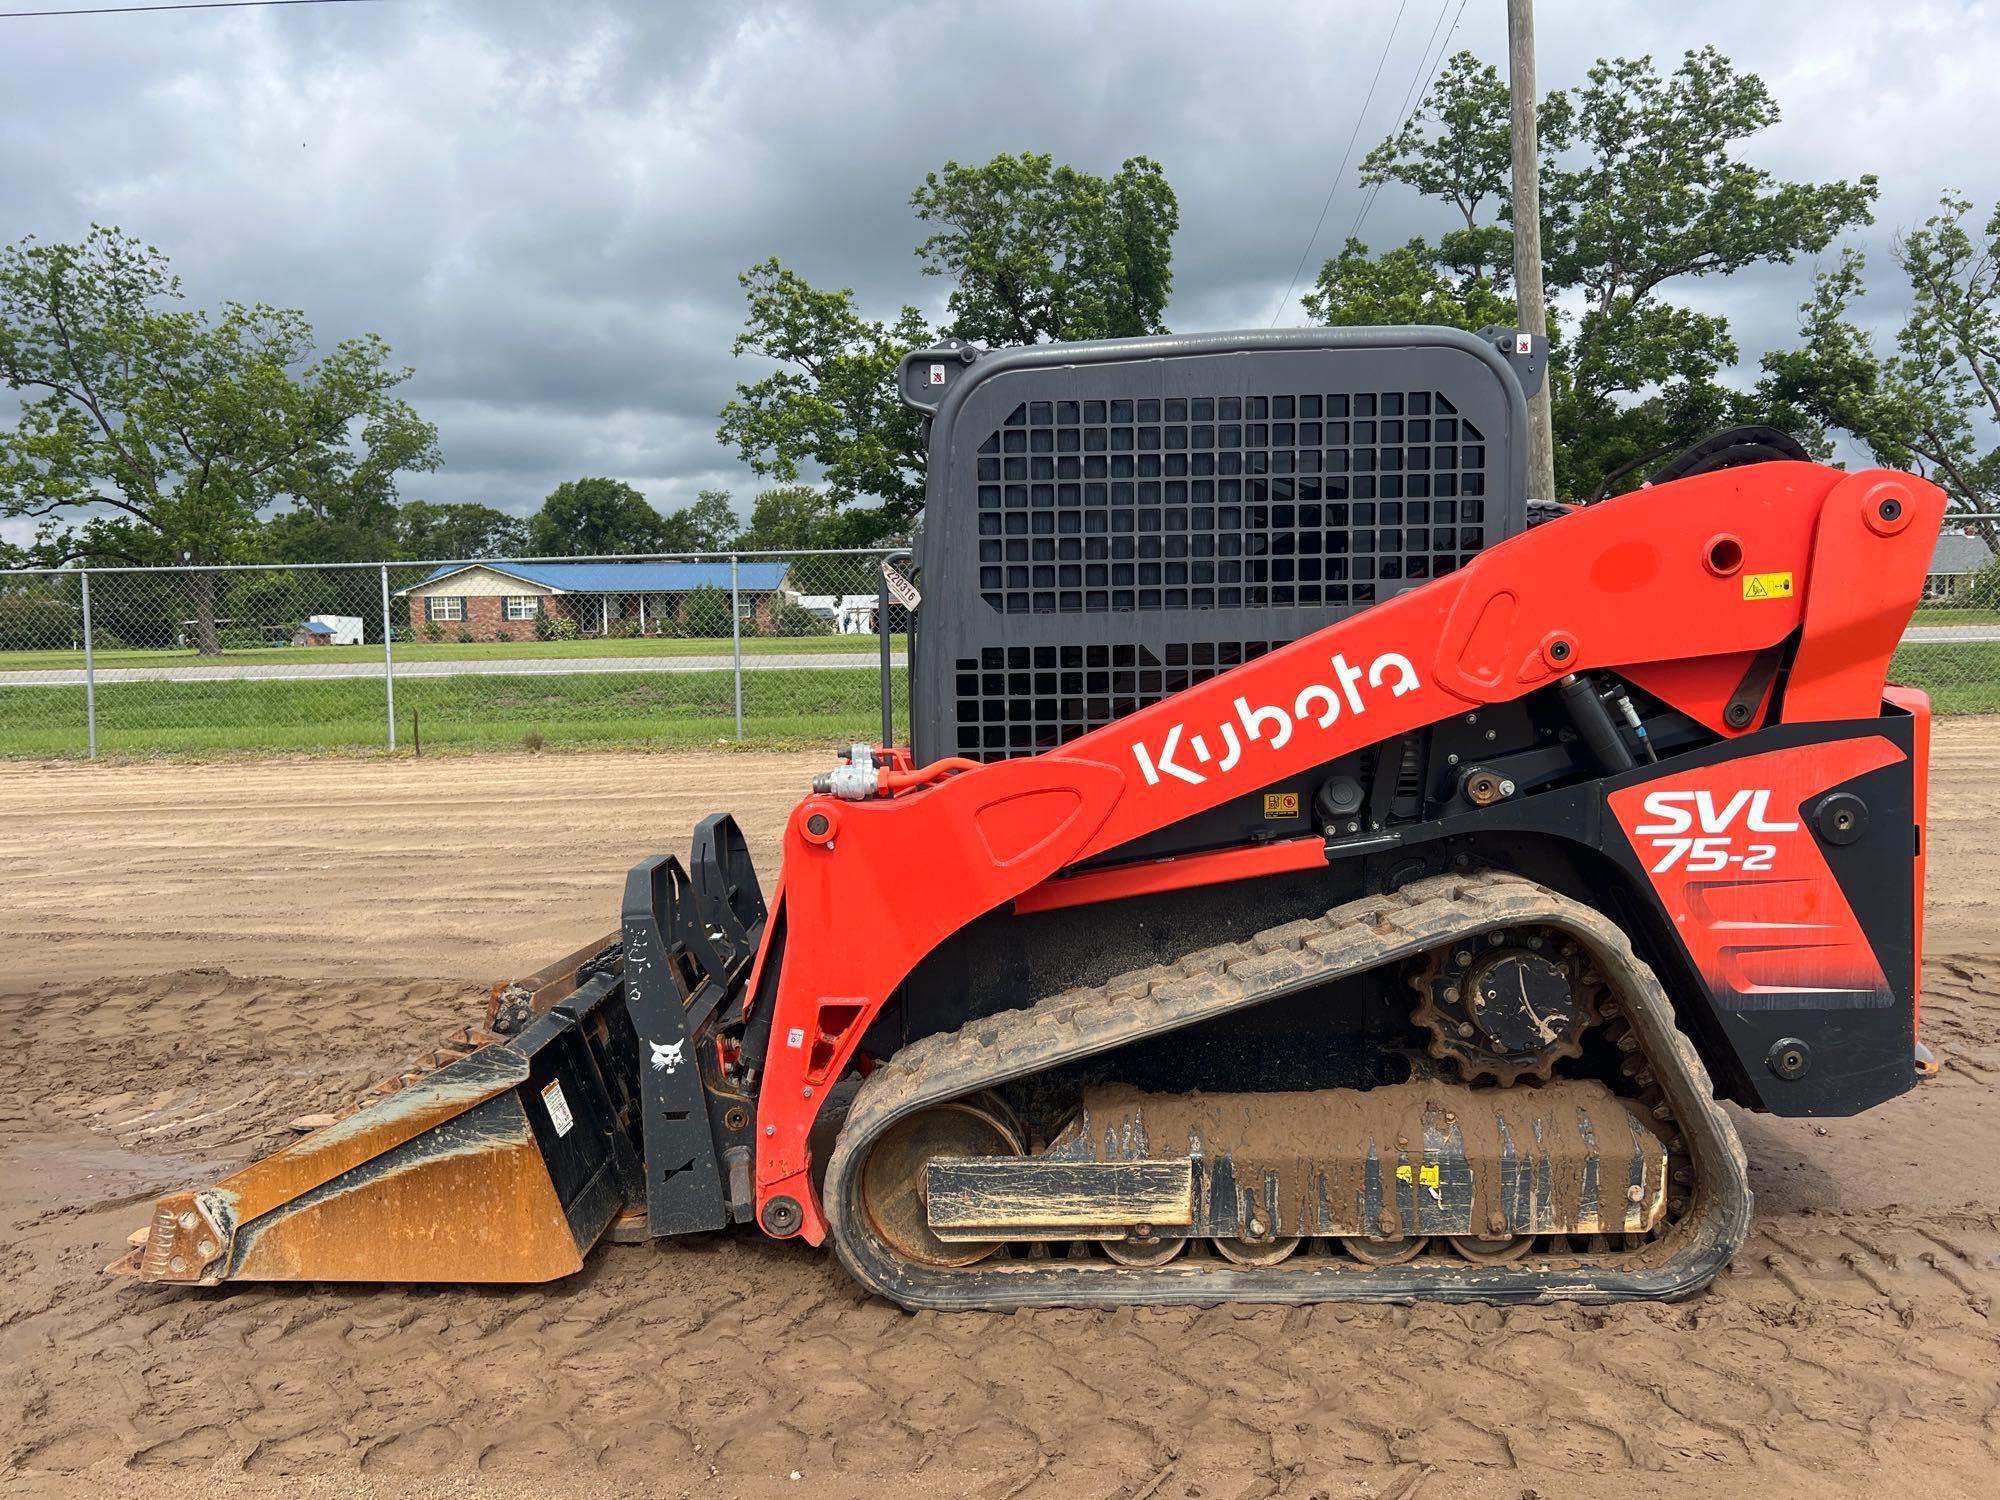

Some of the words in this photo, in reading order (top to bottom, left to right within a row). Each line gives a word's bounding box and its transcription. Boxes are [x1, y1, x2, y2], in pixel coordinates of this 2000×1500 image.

[887, 569, 916, 601] 220316
[1131, 652, 1421, 786] Kubota
[1634, 789, 1799, 835] SVL
[1650, 838, 1777, 873] 75-2
